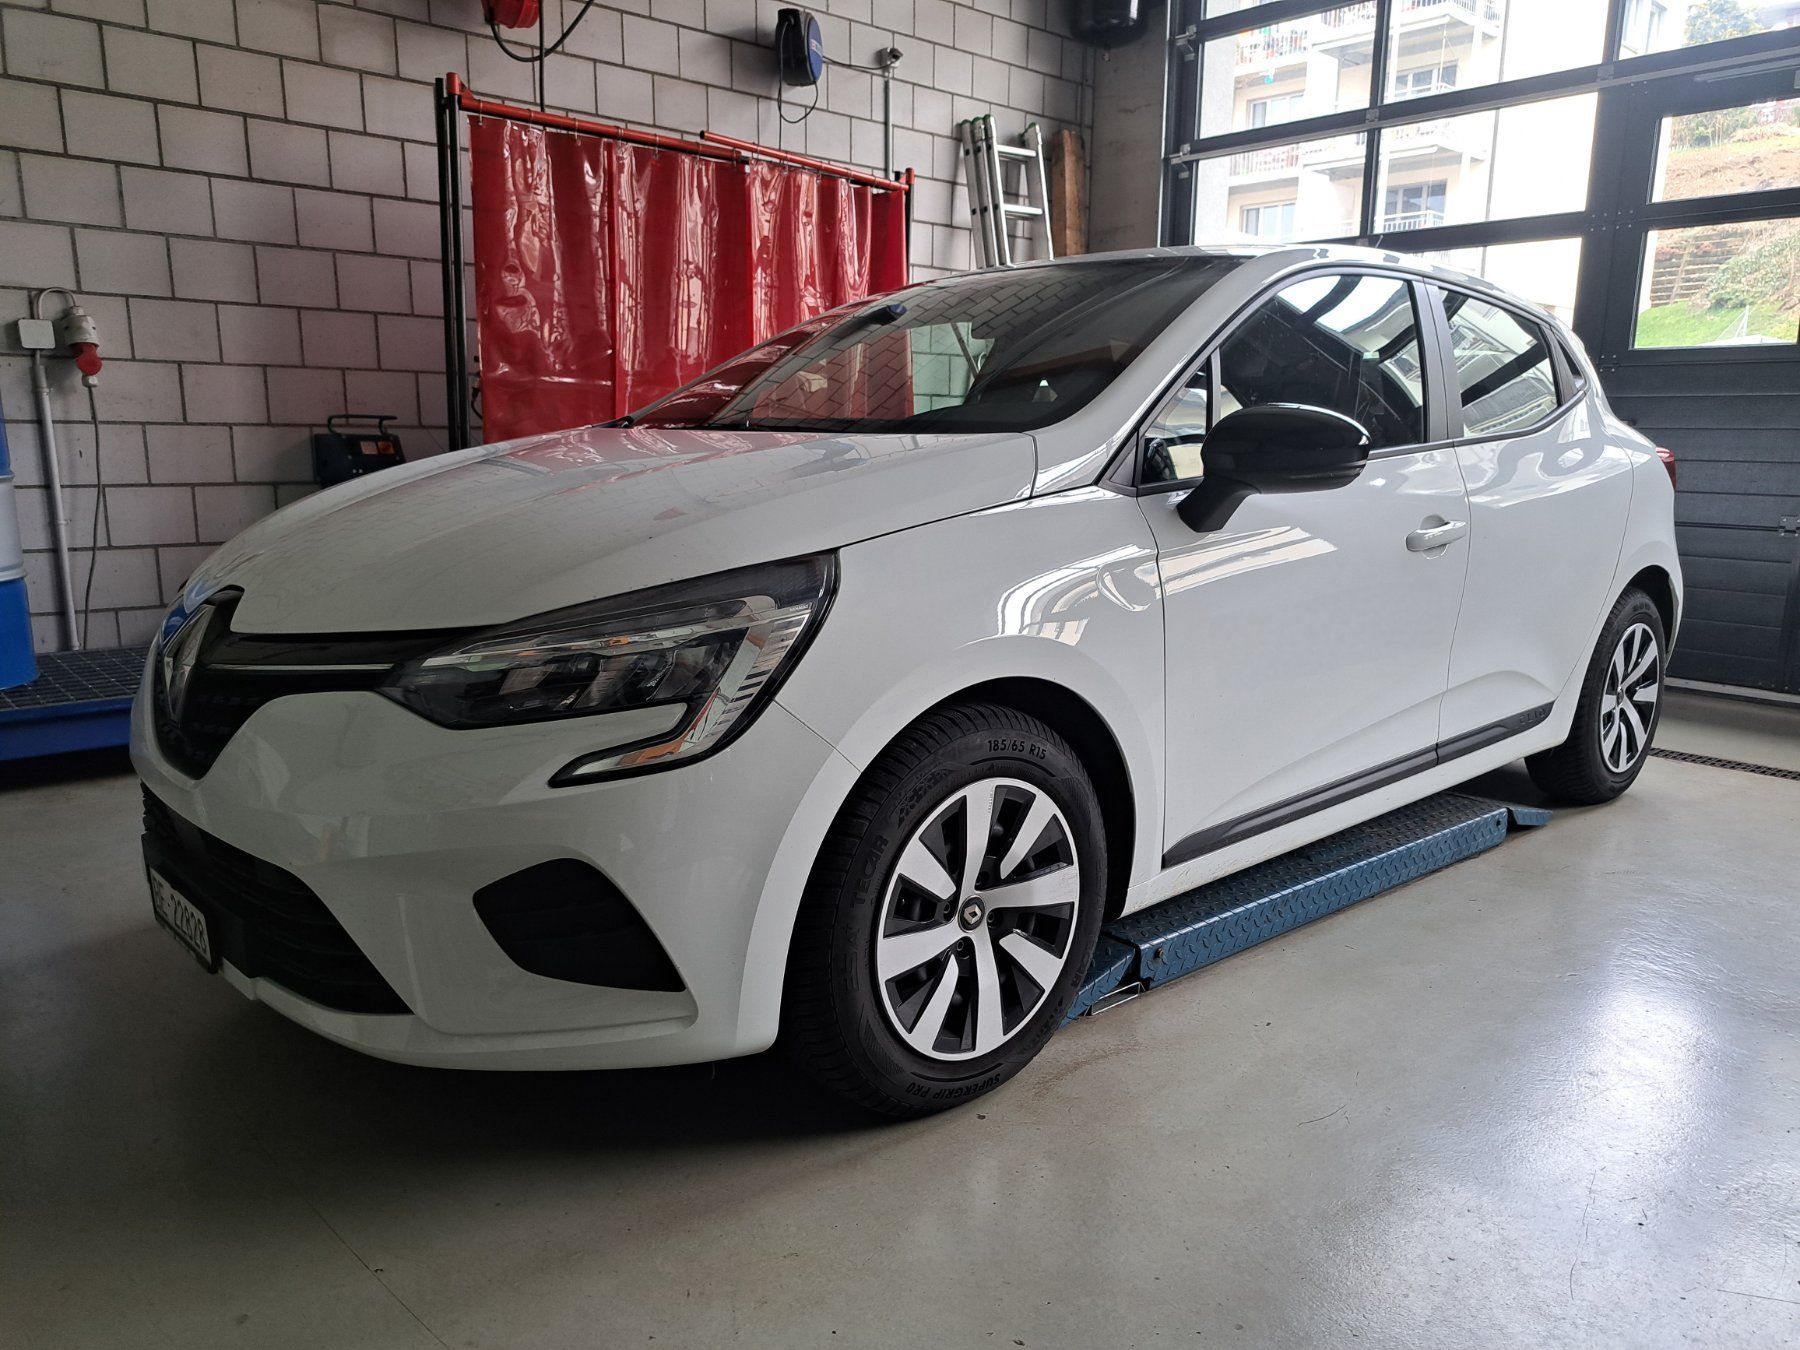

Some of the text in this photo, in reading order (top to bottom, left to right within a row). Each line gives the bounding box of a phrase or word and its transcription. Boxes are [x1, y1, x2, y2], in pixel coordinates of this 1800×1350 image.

[987, 739, 1047, 760] 185/65 R15
[905, 1073, 1001, 1100] SUPERGRIP PRO
